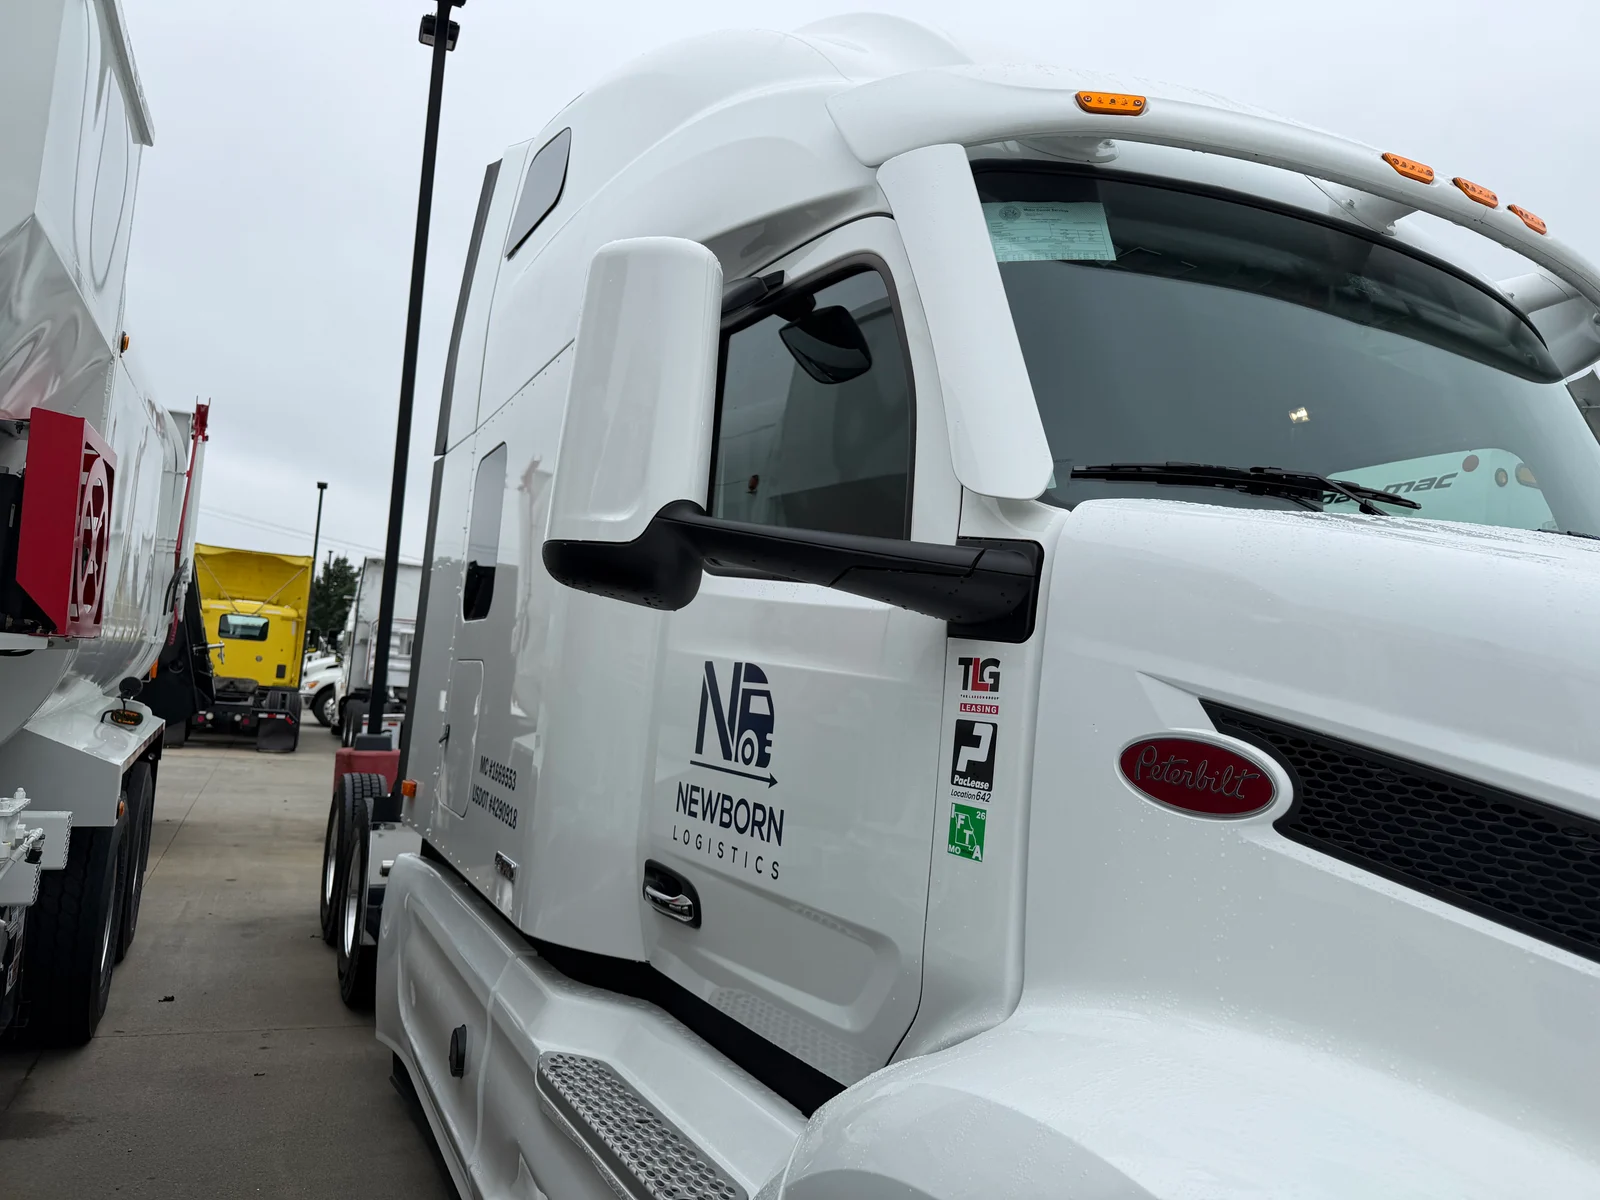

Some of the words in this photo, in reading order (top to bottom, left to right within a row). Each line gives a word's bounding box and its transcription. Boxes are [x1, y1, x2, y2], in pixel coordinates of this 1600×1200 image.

[958, 657, 1001, 692] TLG
[960, 704, 998, 714] LEASING
[479, 754, 490, 777] MC
[1135, 745, 1261, 799] Peterbilt
[953, 775, 990, 790] PacLease
[472, 783, 490, 811] USDOT
[950, 789, 976, 801] Location
[975, 791, 992, 803] 642
[676, 781, 784, 847] NEWBORN
[976, 811, 986, 821] 26
[673, 825, 779, 880] LOGISTICS
[947, 844, 961, 855] MO
